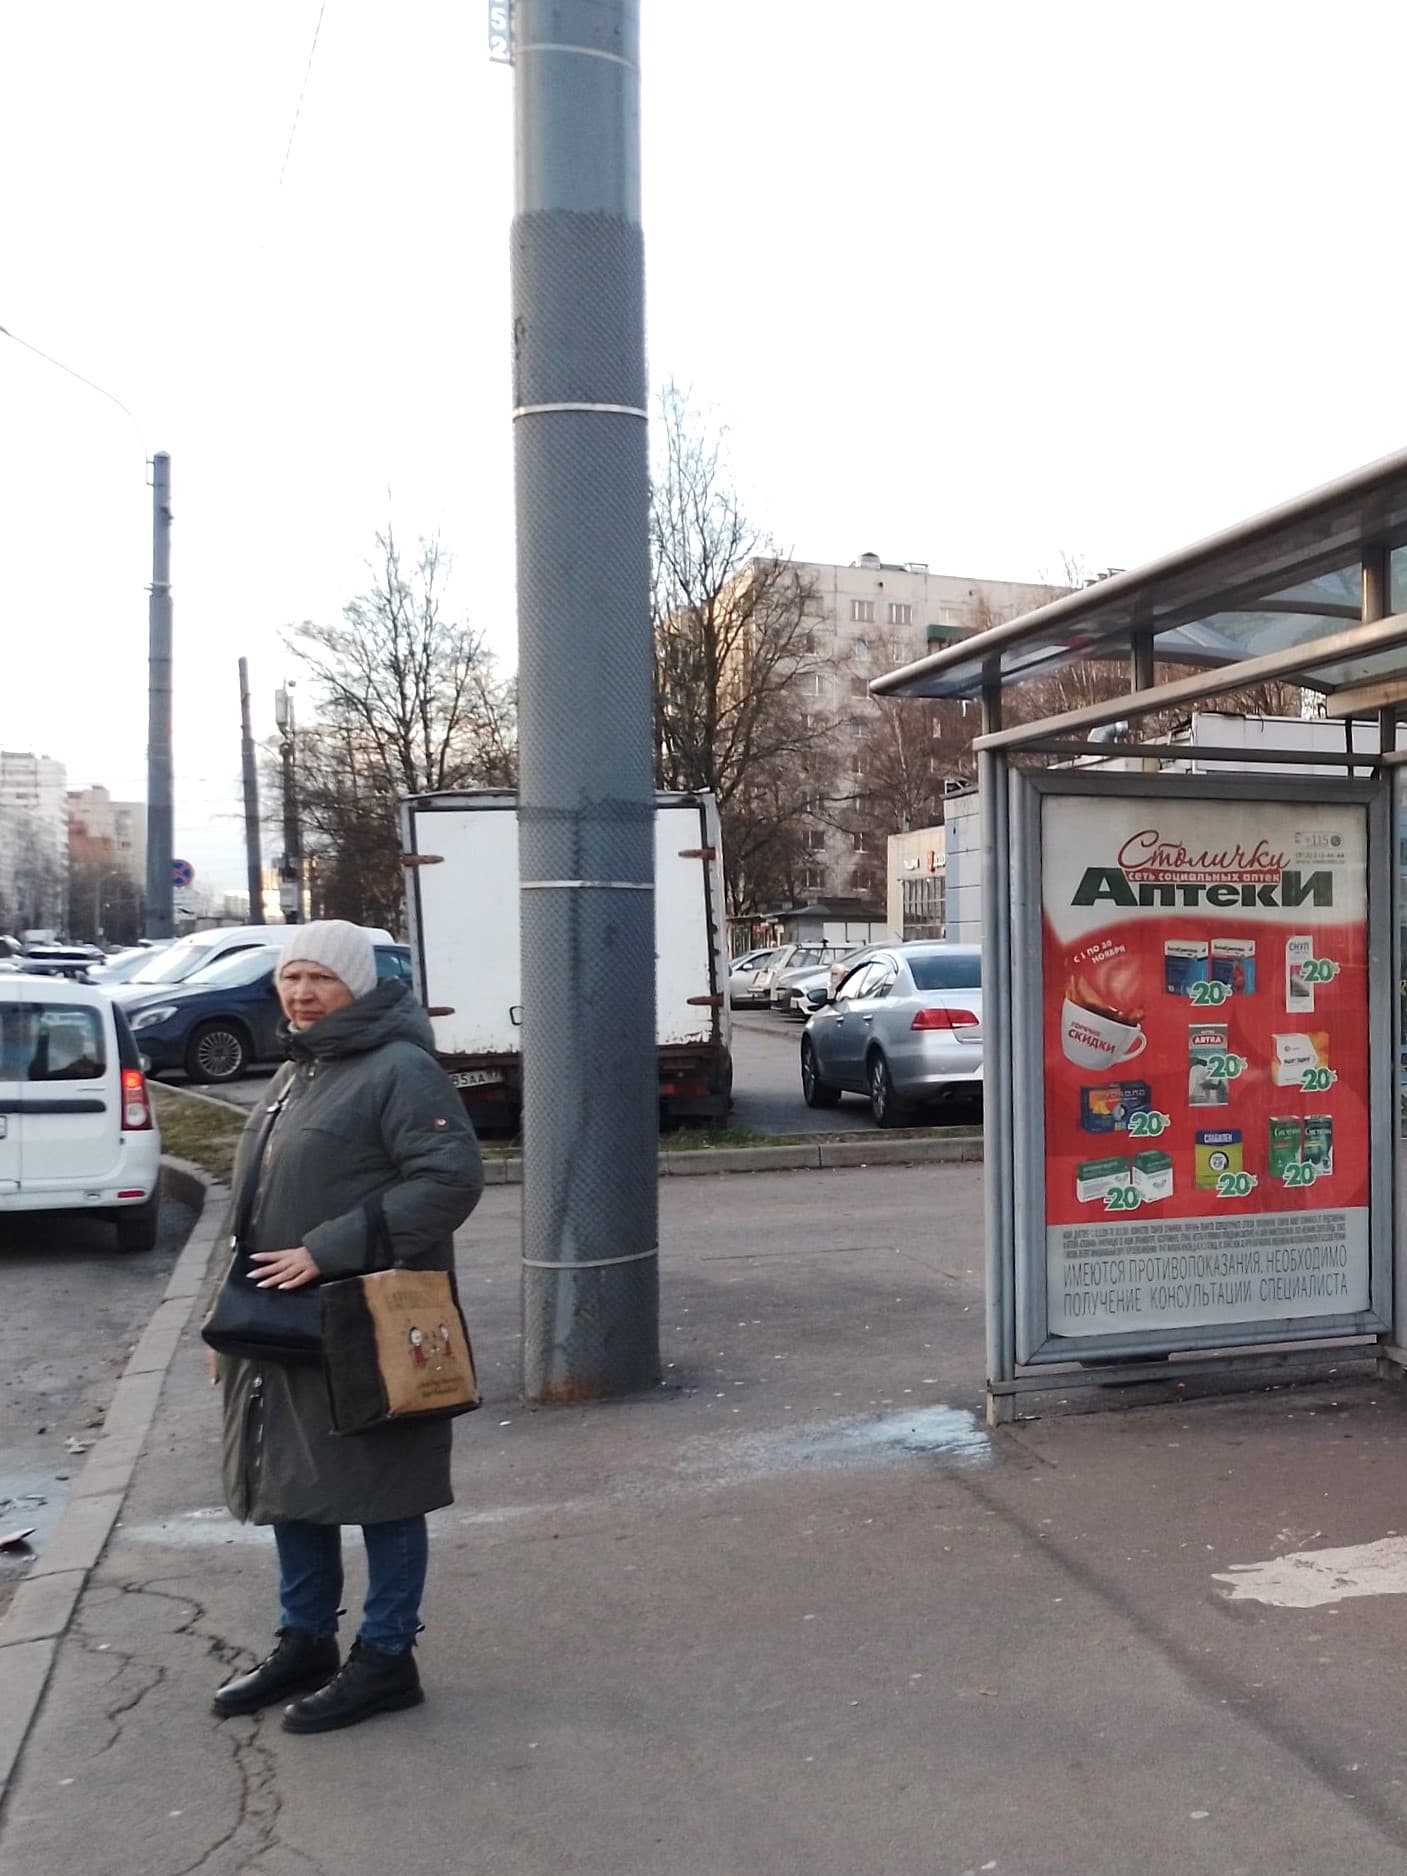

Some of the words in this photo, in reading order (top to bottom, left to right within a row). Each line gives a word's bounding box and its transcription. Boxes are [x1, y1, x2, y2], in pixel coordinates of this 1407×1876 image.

[1117, 830, 1290, 869] Столички
[1128, 872, 1155, 881] сеть
[1158, 872, 1239, 882] социальных
[1243, 873, 1279, 882] аптек
[1086, 944, 1100, 957] ПО
[1069, 1029, 1116, 1054] СКИДКИ
[1064, 1259, 1125, 1288] ИМЕЮТСЯ
[1266, 1244, 1347, 1273] НЕОБХОДИМО
[1064, 1287, 1142, 1317] ПОЛУЧЕНИЕ
[1150, 1279, 1252, 1310] КОНСУЛЬТАЦИИ
[1259, 1272, 1347, 1302] СПЕЦИАЛИСТА
